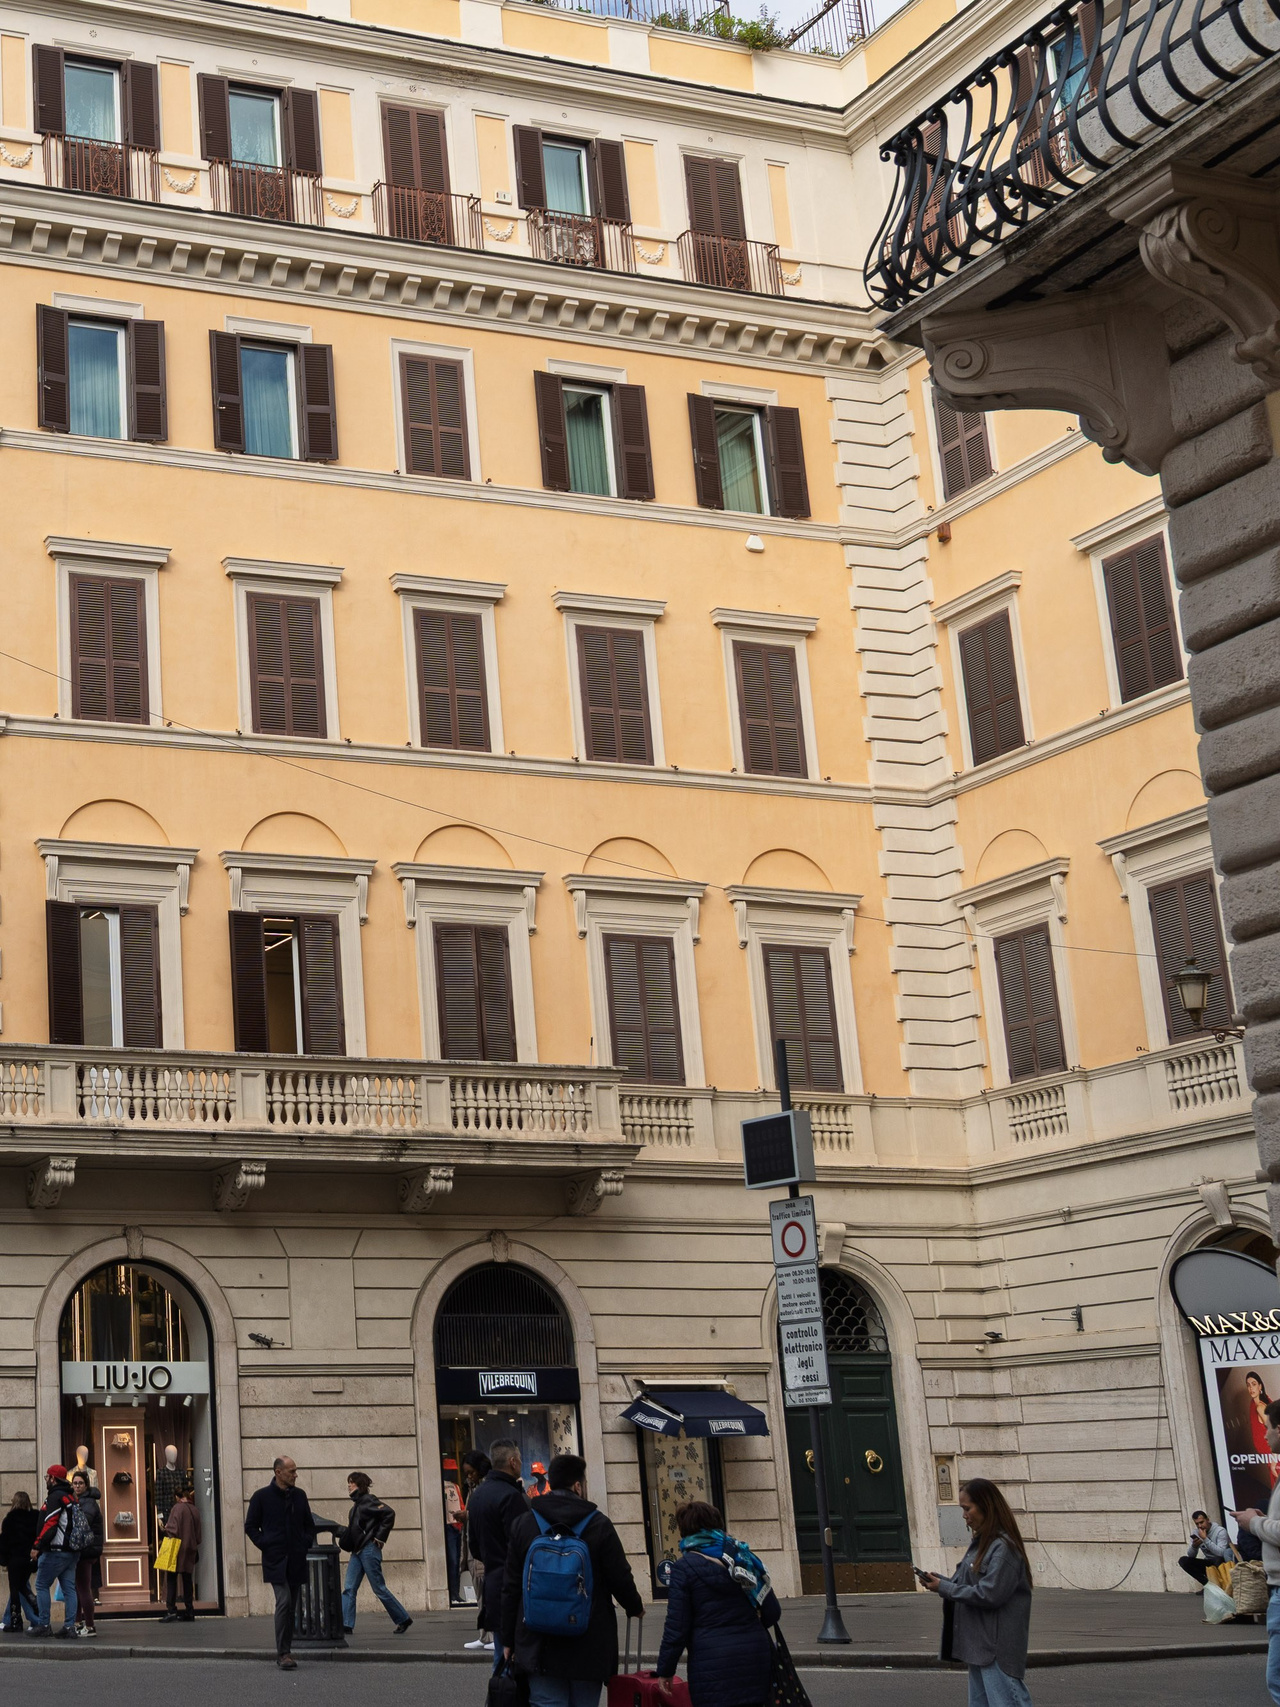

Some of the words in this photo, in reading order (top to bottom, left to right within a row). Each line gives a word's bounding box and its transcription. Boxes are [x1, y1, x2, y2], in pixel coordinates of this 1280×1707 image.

[772, 1211, 791, 1221] traffico
[791, 1209, 811, 1218] limitato
[786, 1326, 818, 1339] controllo
[785, 1341, 823, 1354] elettronico
[481, 1375, 535, 1394] VILEBREQUIN
[710, 1421, 745, 1433] VILEBREQUIN
[1230, 1453, 1280, 1465] OPENIN
